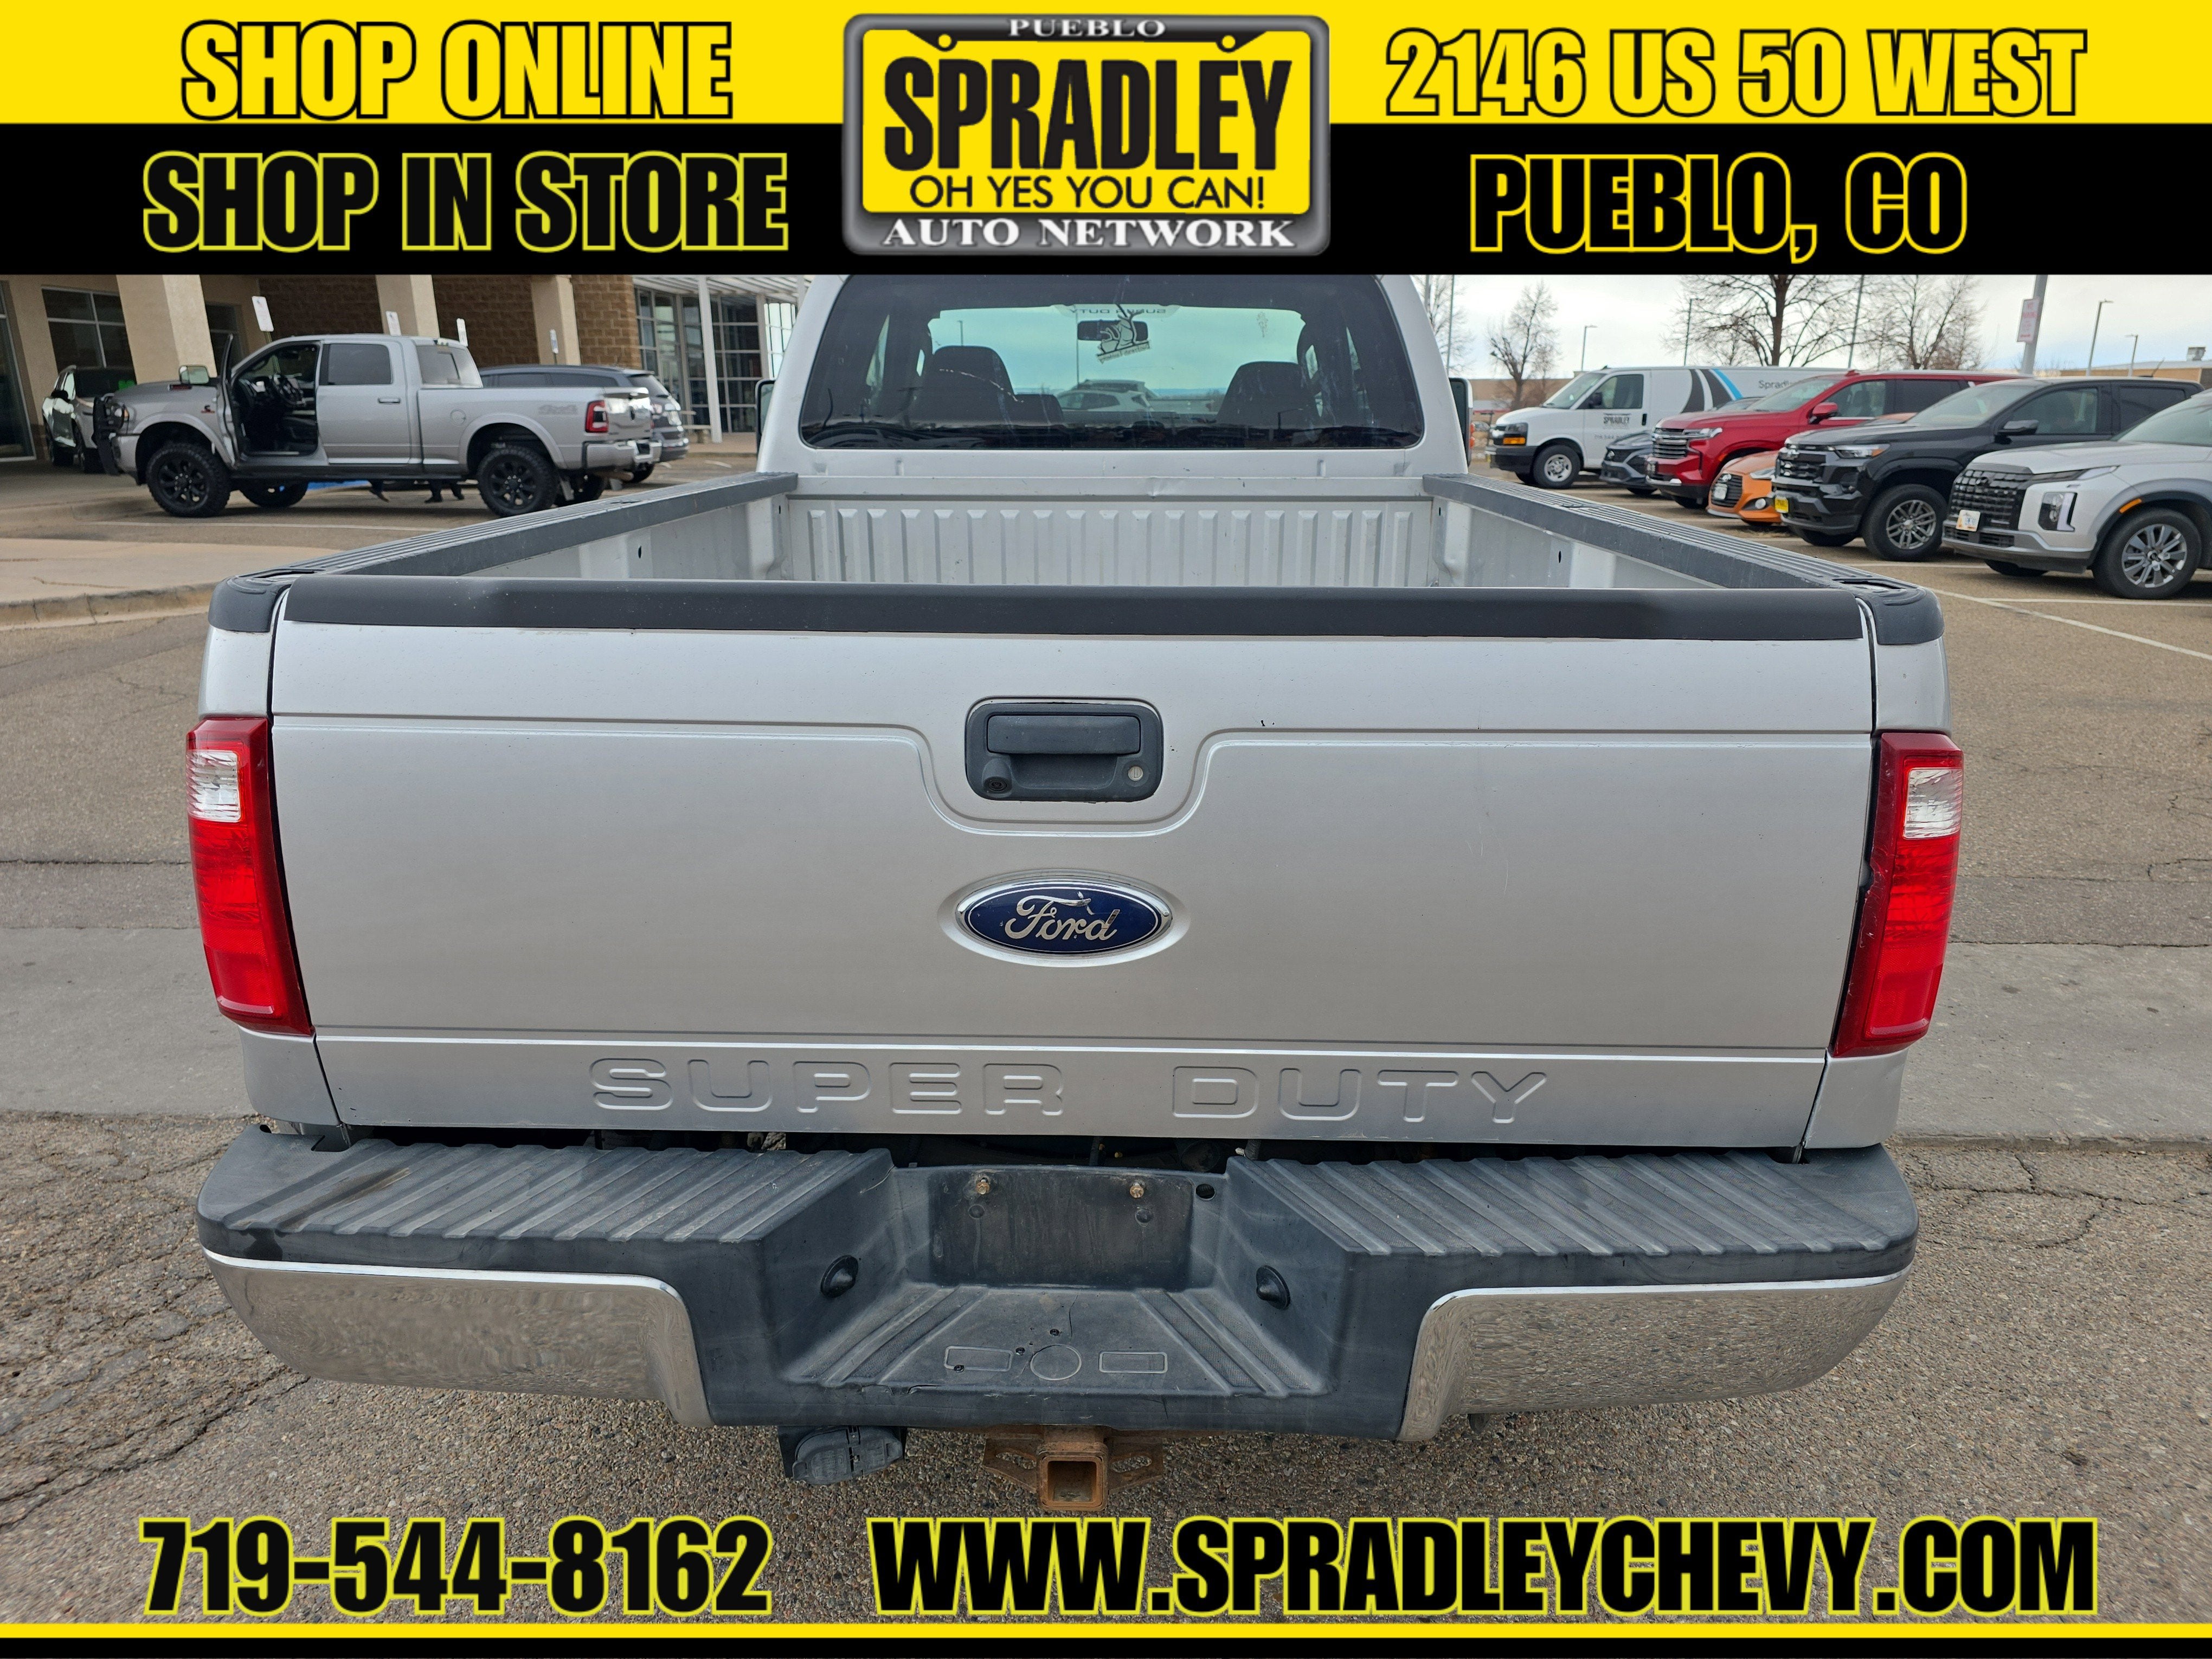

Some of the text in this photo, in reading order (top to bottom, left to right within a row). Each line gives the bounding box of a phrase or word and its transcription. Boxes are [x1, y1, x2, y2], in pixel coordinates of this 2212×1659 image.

[1005, 895, 1120, 941] Ford
[589, 1057, 1547, 1124] SUPER DUTY
